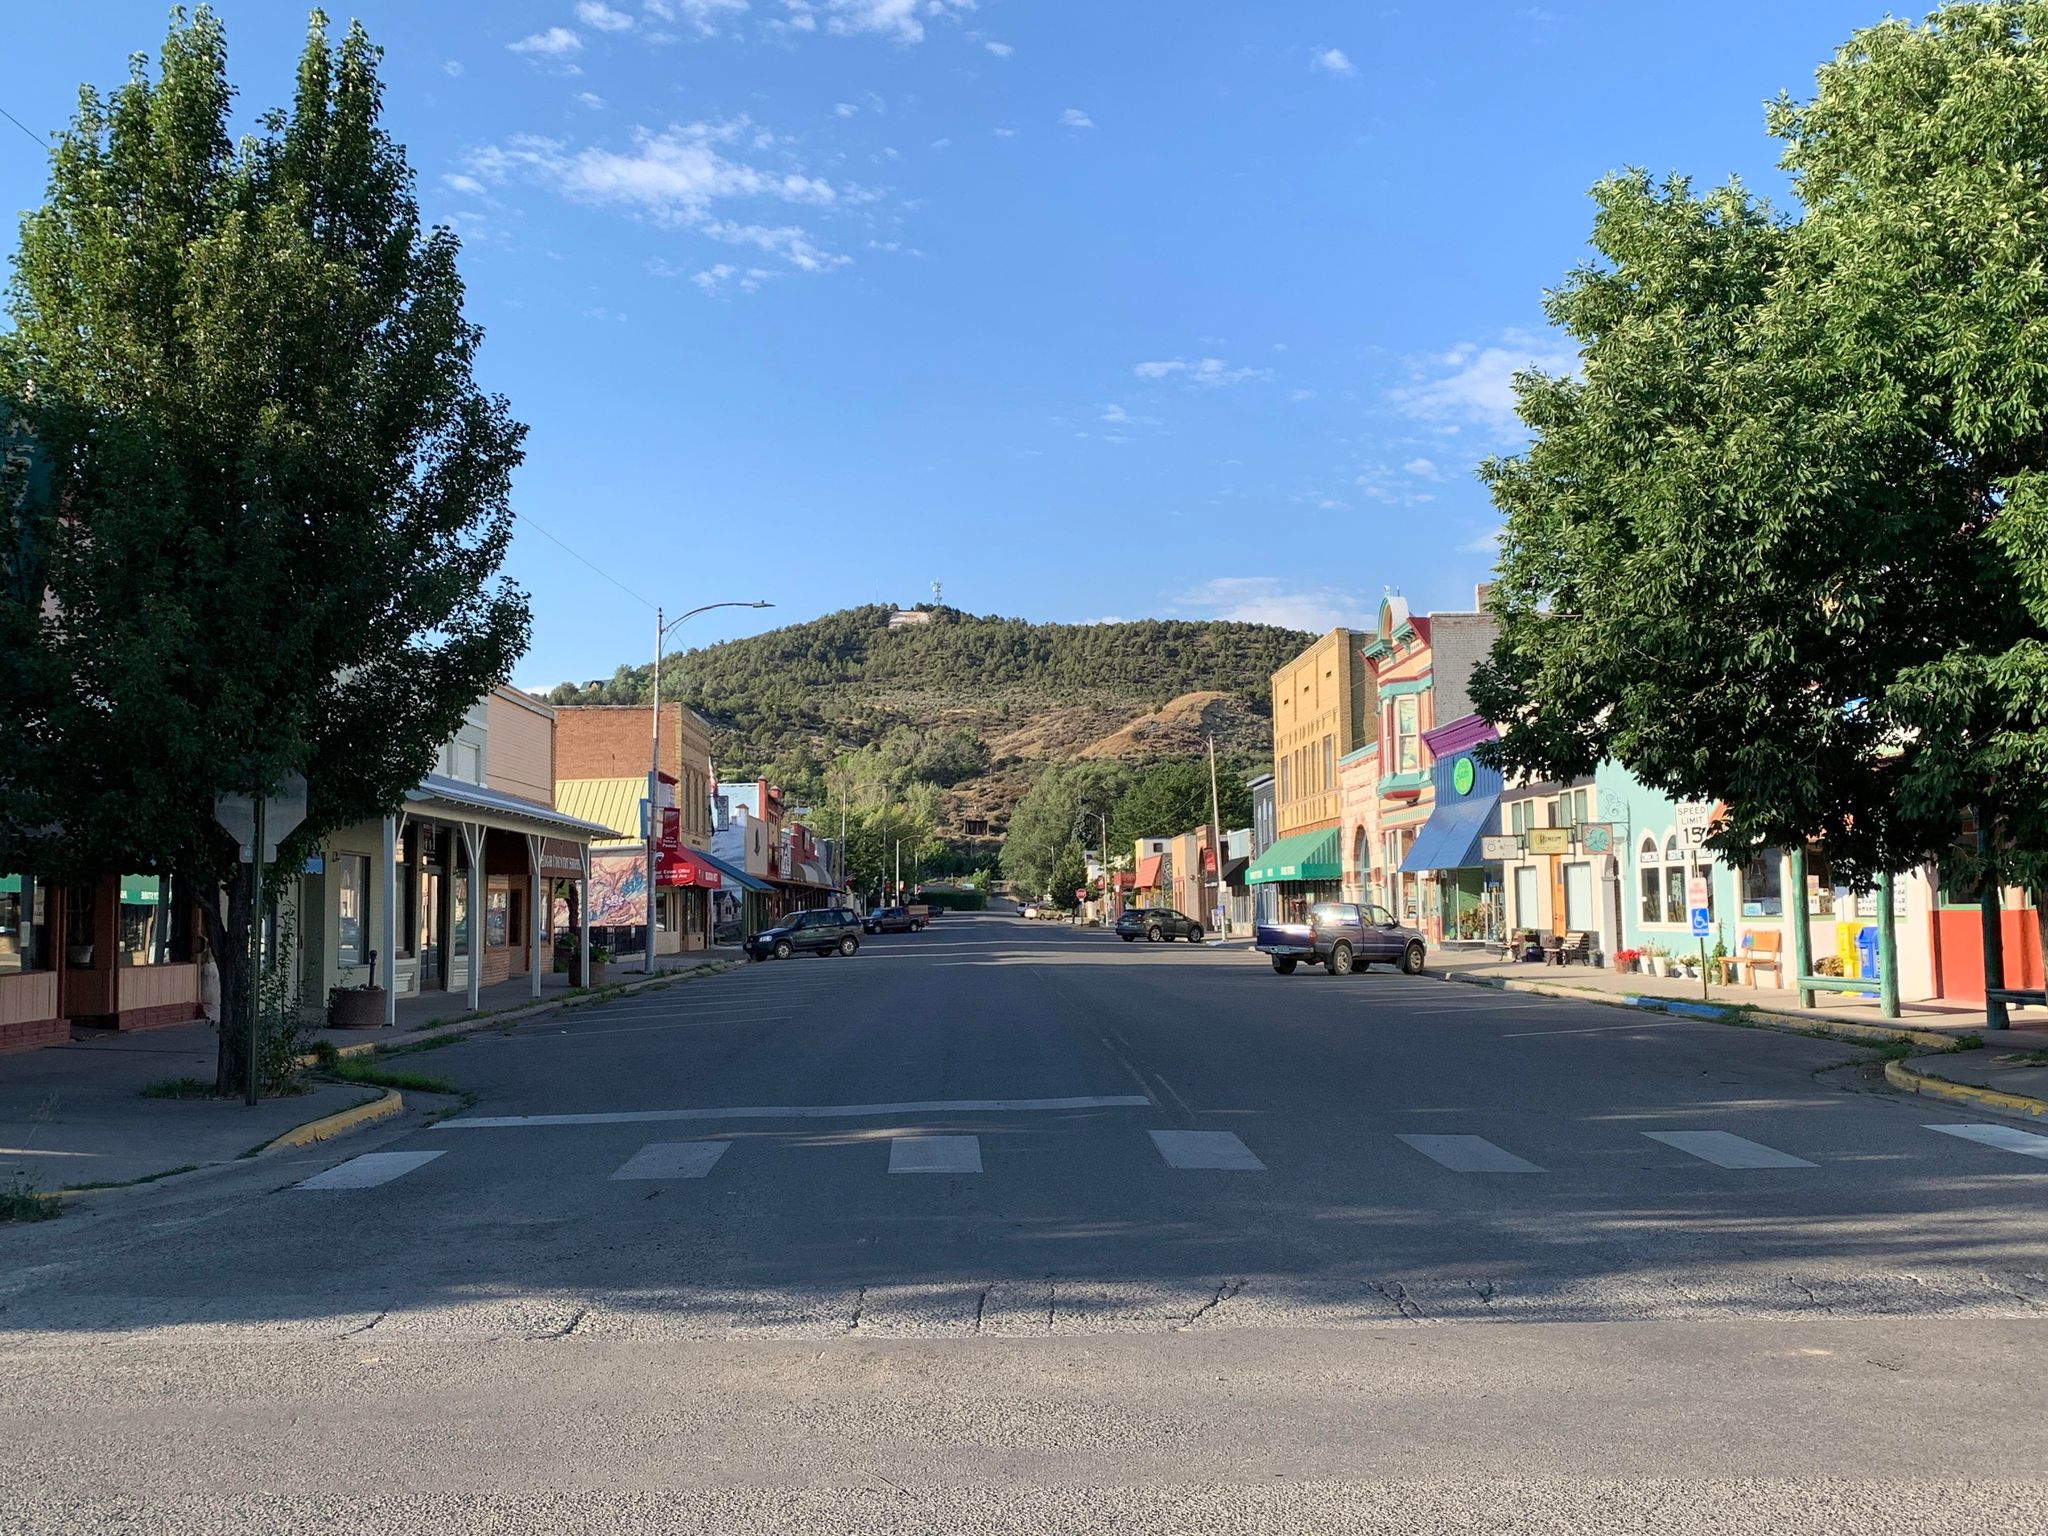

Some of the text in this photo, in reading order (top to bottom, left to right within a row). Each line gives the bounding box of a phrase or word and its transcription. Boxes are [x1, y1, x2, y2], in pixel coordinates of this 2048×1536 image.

[1677, 806, 1706, 816] SPEED
[1681, 816, 1703, 825] LIMIT
[1683, 827, 1704, 844] 15
